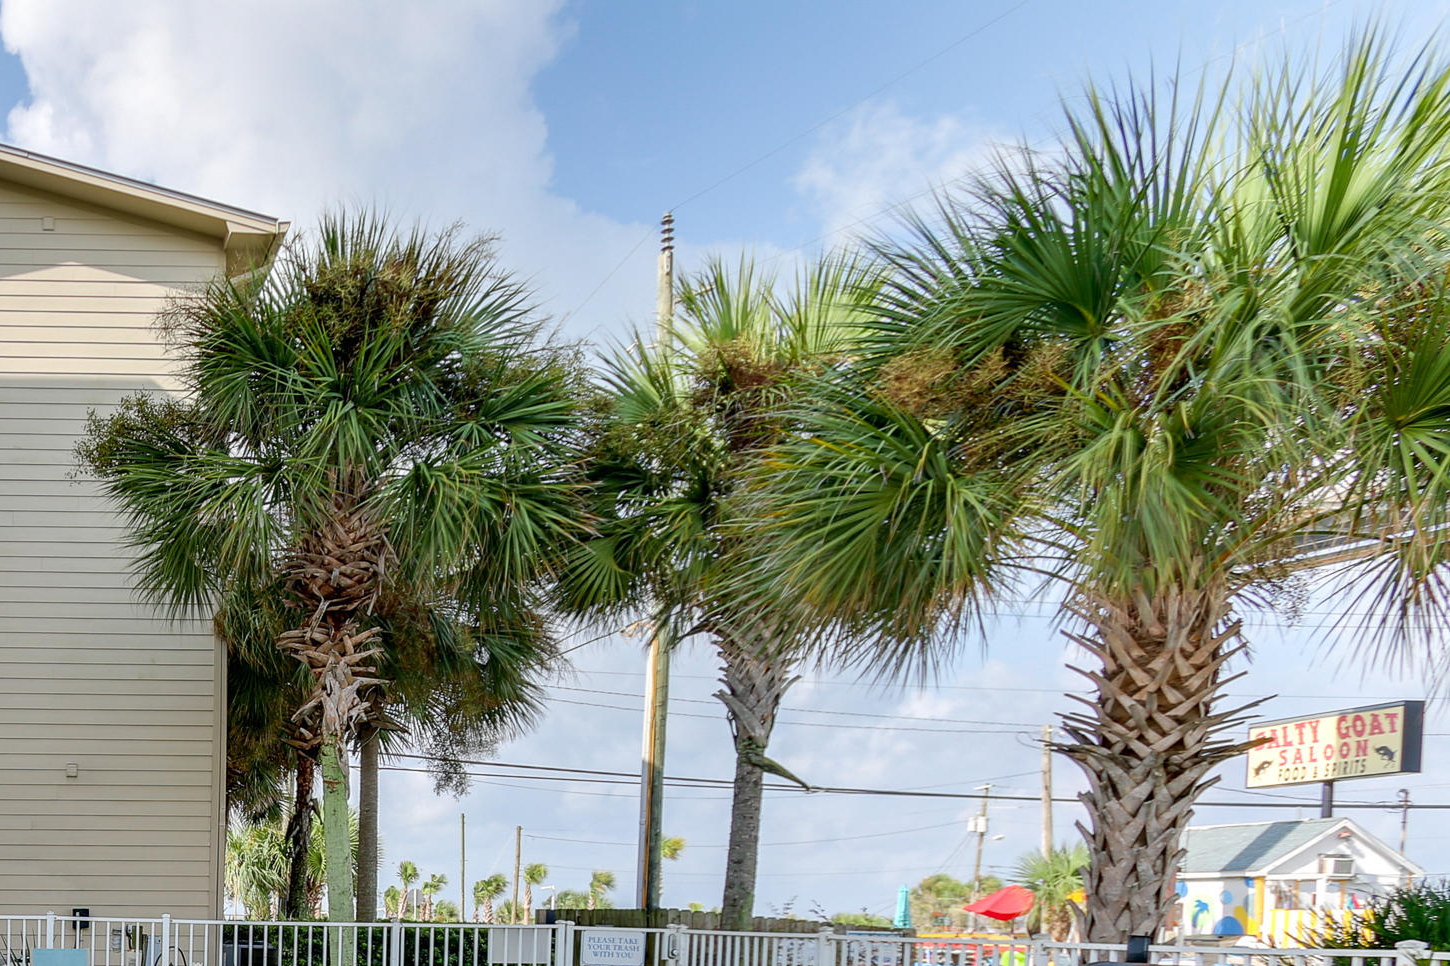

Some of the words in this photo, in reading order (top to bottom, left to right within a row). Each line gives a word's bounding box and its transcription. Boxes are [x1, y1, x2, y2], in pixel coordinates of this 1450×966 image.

[1254, 720, 1320, 751] SALTY
[1336, 713, 1399, 740] GOAT
[1279, 739, 1368, 766] SALOON
[1278, 766, 1307, 781] FOOD
[1324, 759, 1366, 778] SPIRITS
[588, 936, 615, 944] PLEASE
[619, 937, 639, 945] TAKE
[613, 944, 640, 952] TRASH
[616, 951, 634, 959] YOU
